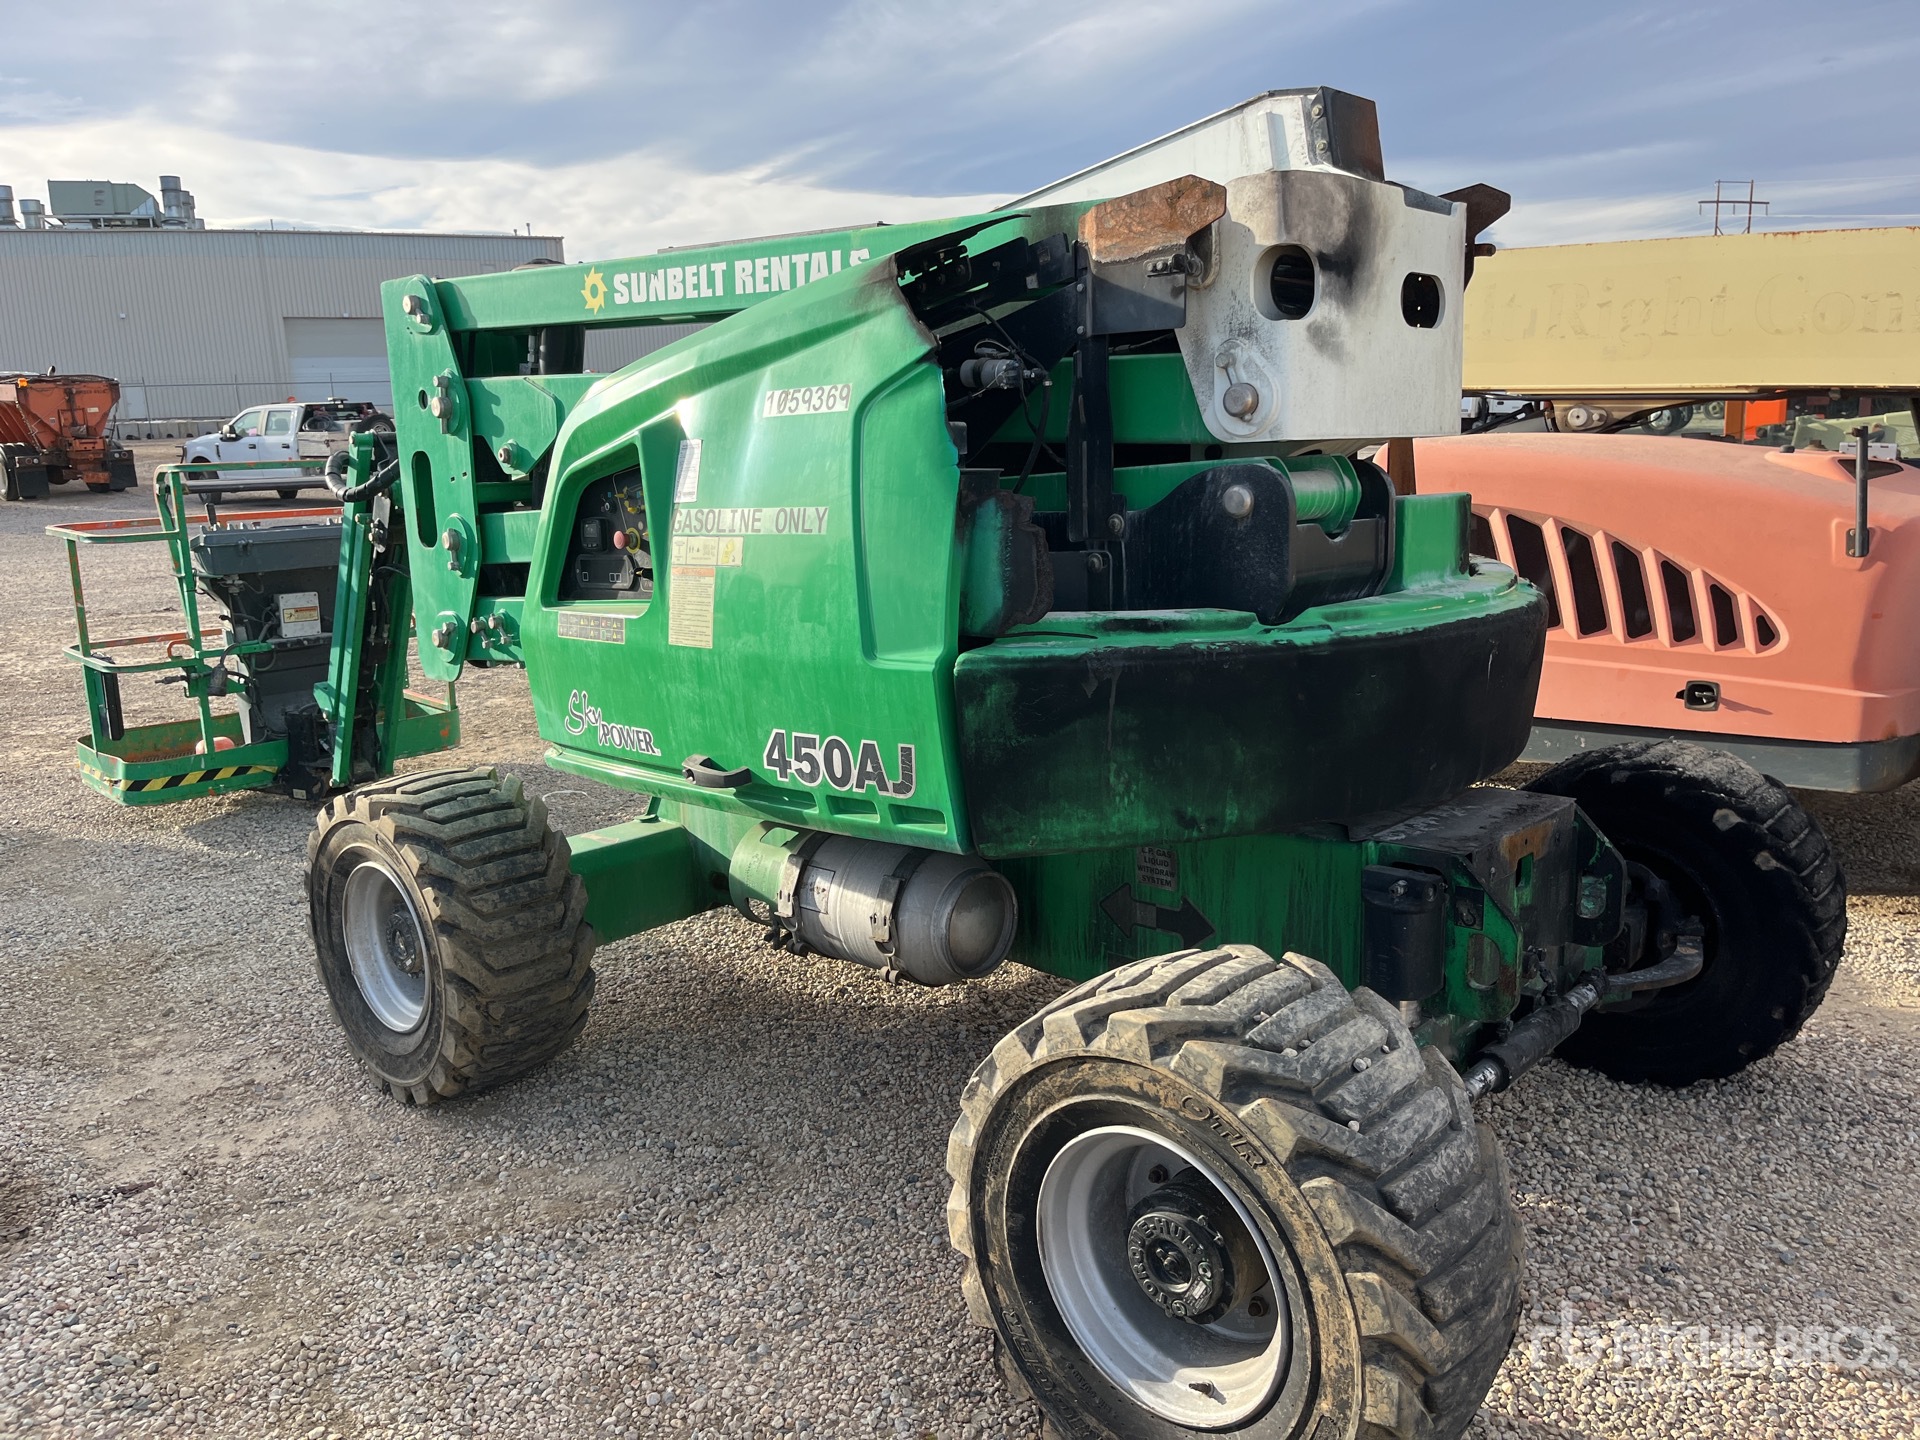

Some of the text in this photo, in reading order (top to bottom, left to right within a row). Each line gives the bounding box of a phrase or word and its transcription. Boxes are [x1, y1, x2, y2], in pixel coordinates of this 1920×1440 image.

[613, 261, 728, 305] SUNBELT
[766, 384, 851, 415] 1059369
[672, 507, 829, 534] GASOLINE ONLY
[600, 722, 657, 755] POWER
[764, 729, 915, 799] 450AJ
[1143, 856, 1169, 867] LIQUID
[1156, 849, 1172, 858] GAS
[1142, 875, 1172, 887] SYSTEM
